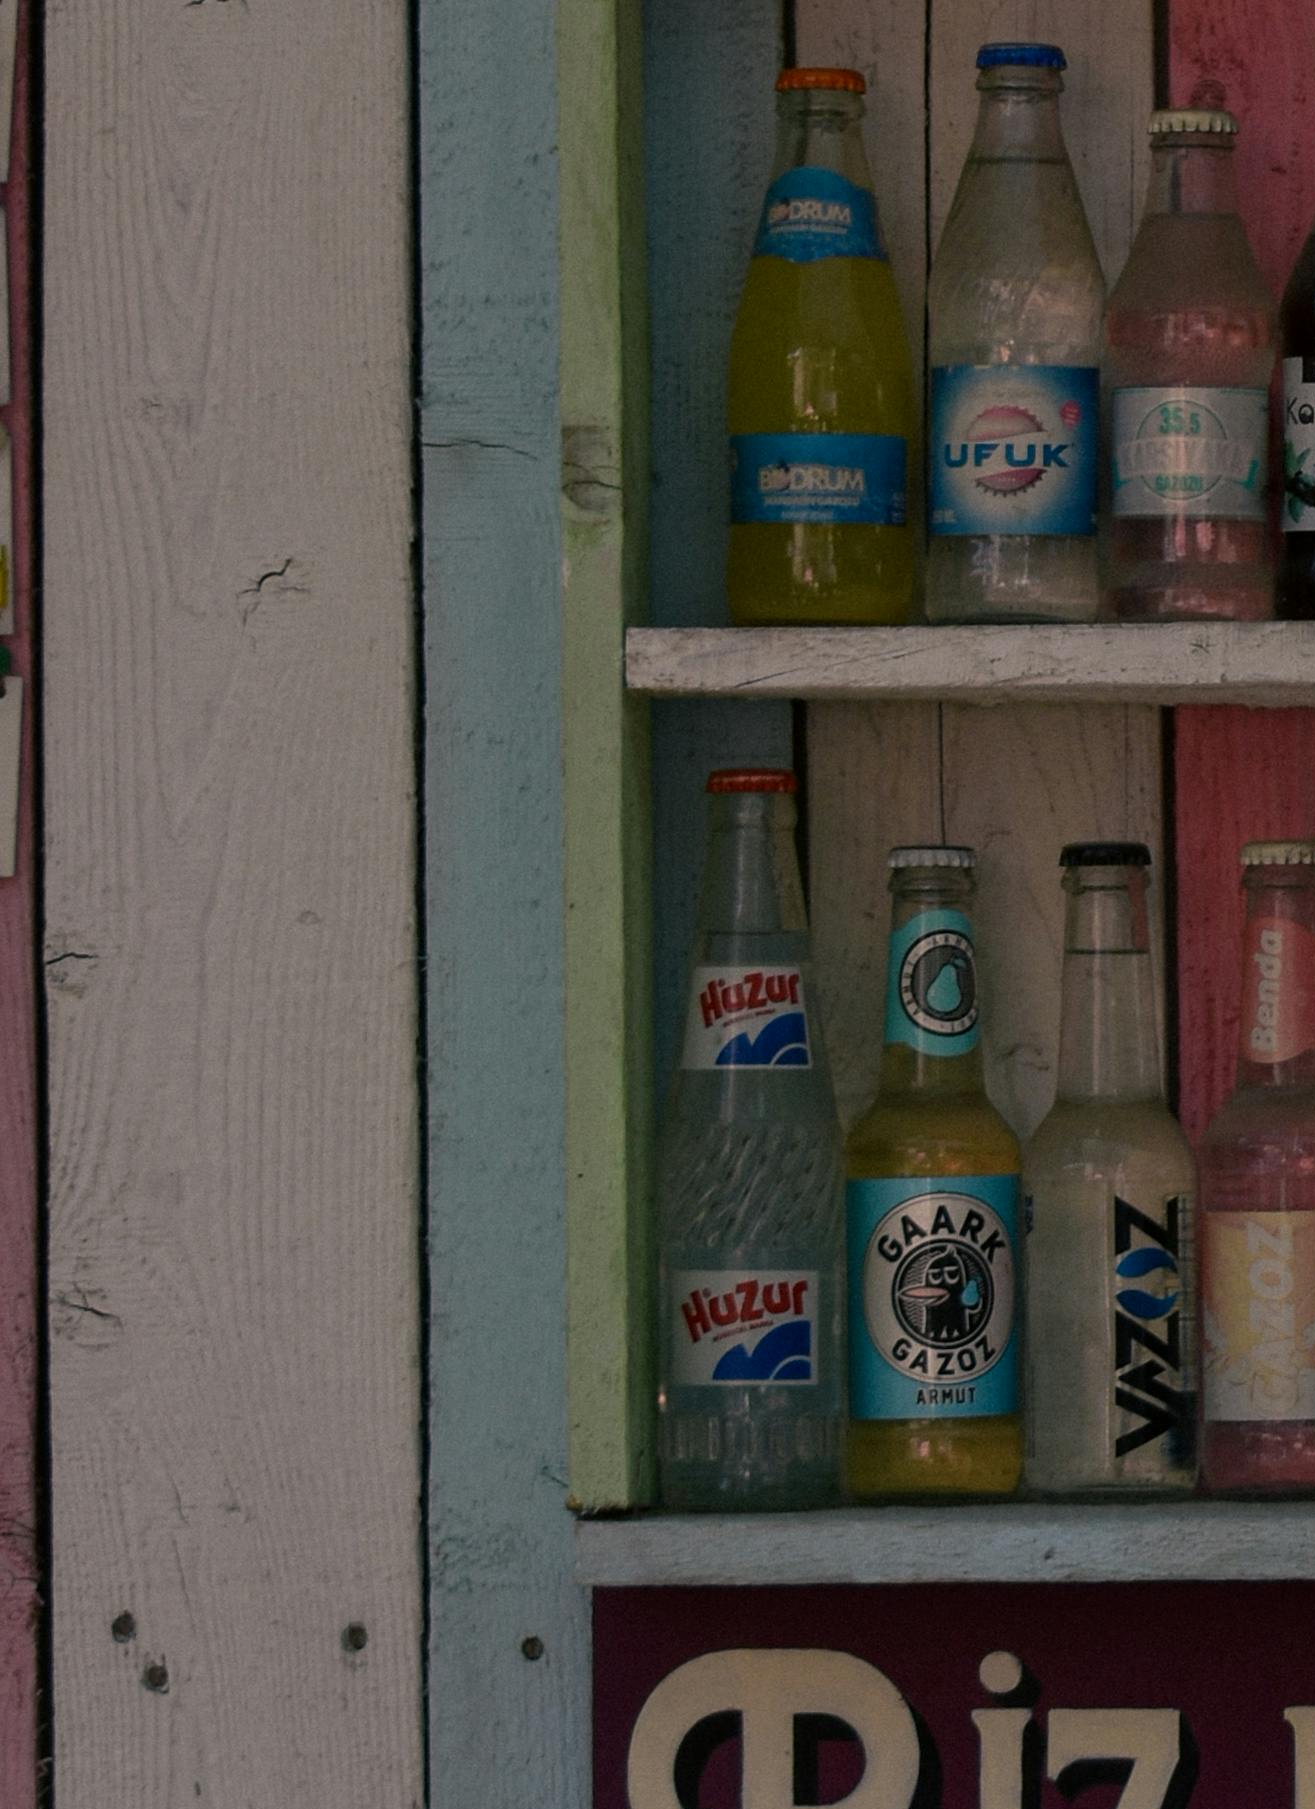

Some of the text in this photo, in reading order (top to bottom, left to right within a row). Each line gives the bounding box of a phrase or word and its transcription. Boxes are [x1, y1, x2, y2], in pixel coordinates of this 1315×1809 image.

[944, 443, 1070, 469] UFUK
[1249, 929, 1284, 1053] Benda
[878, 1205, 1005, 1264] GAARK
[1246, 1221, 1297, 1411] GAZOZ
[892, 1338, 997, 1376] GAZOZ
[916, 1388, 977, 1405] ARMUT
